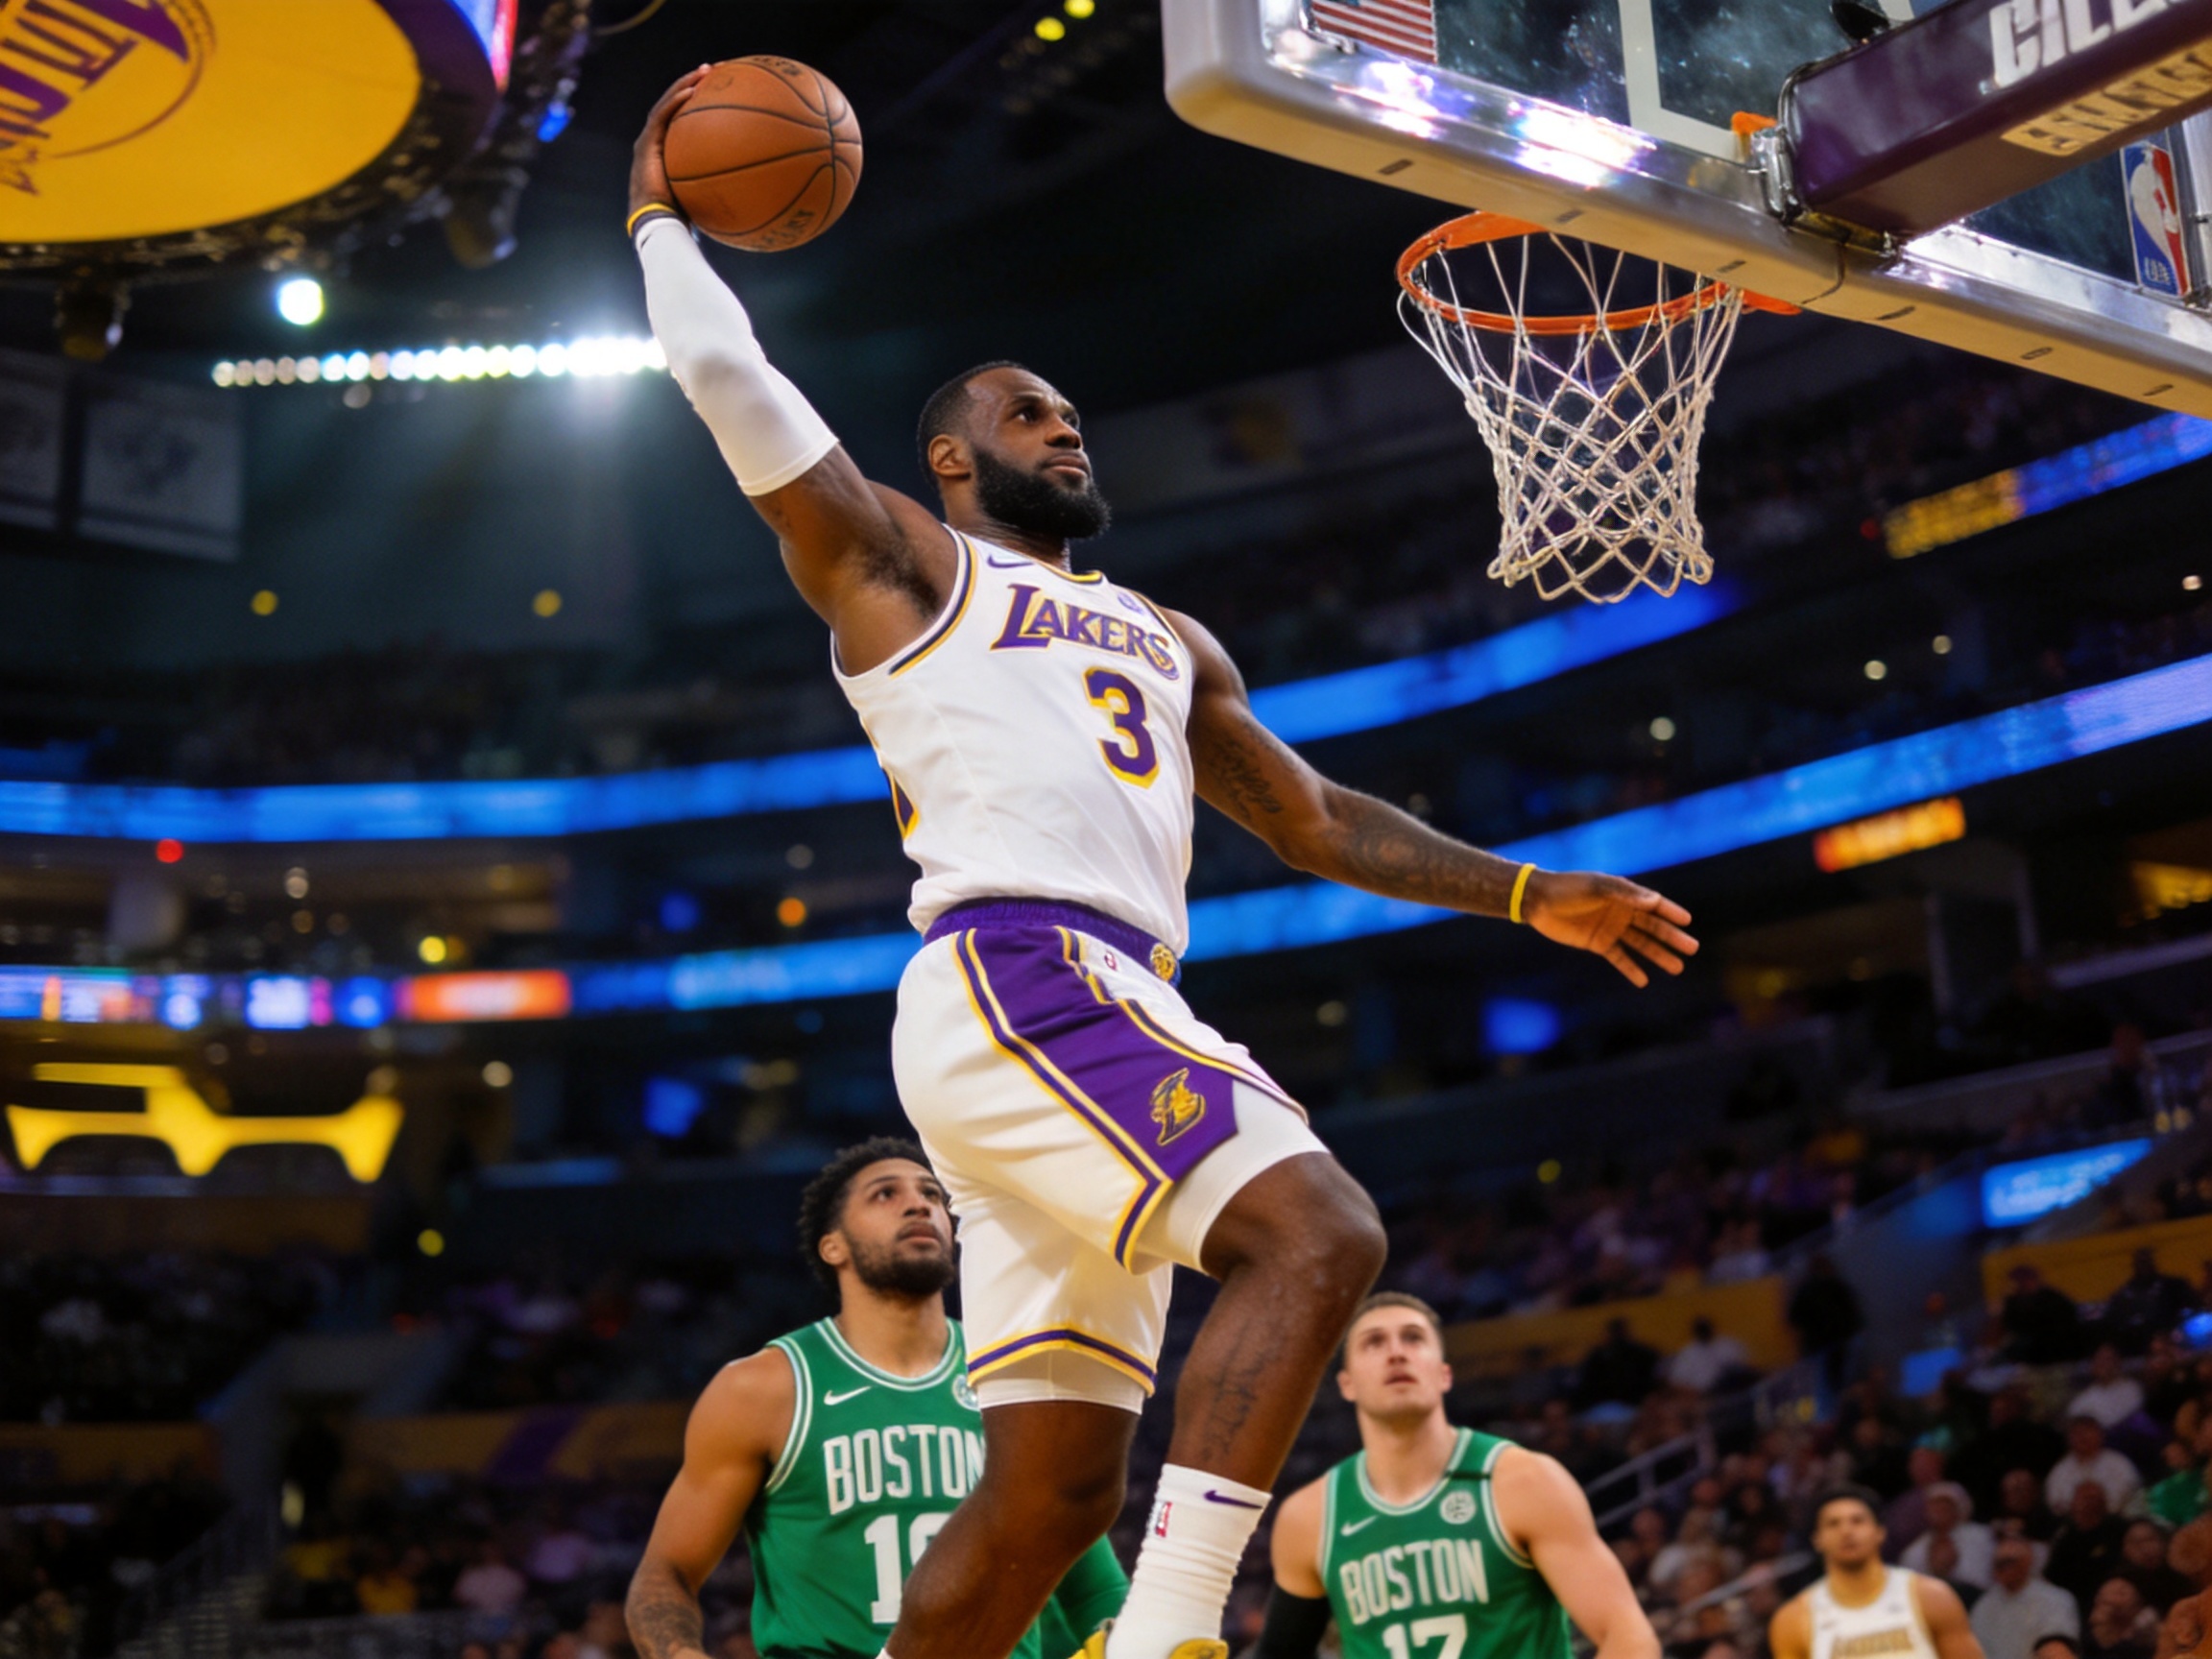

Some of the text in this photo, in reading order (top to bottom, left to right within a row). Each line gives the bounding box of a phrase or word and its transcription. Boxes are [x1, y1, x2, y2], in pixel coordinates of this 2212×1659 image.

[990, 583, 1180, 681] LAKERS
[1081, 665, 1160, 789] 3
[1339, 1538, 1489, 1625] BOSTON
